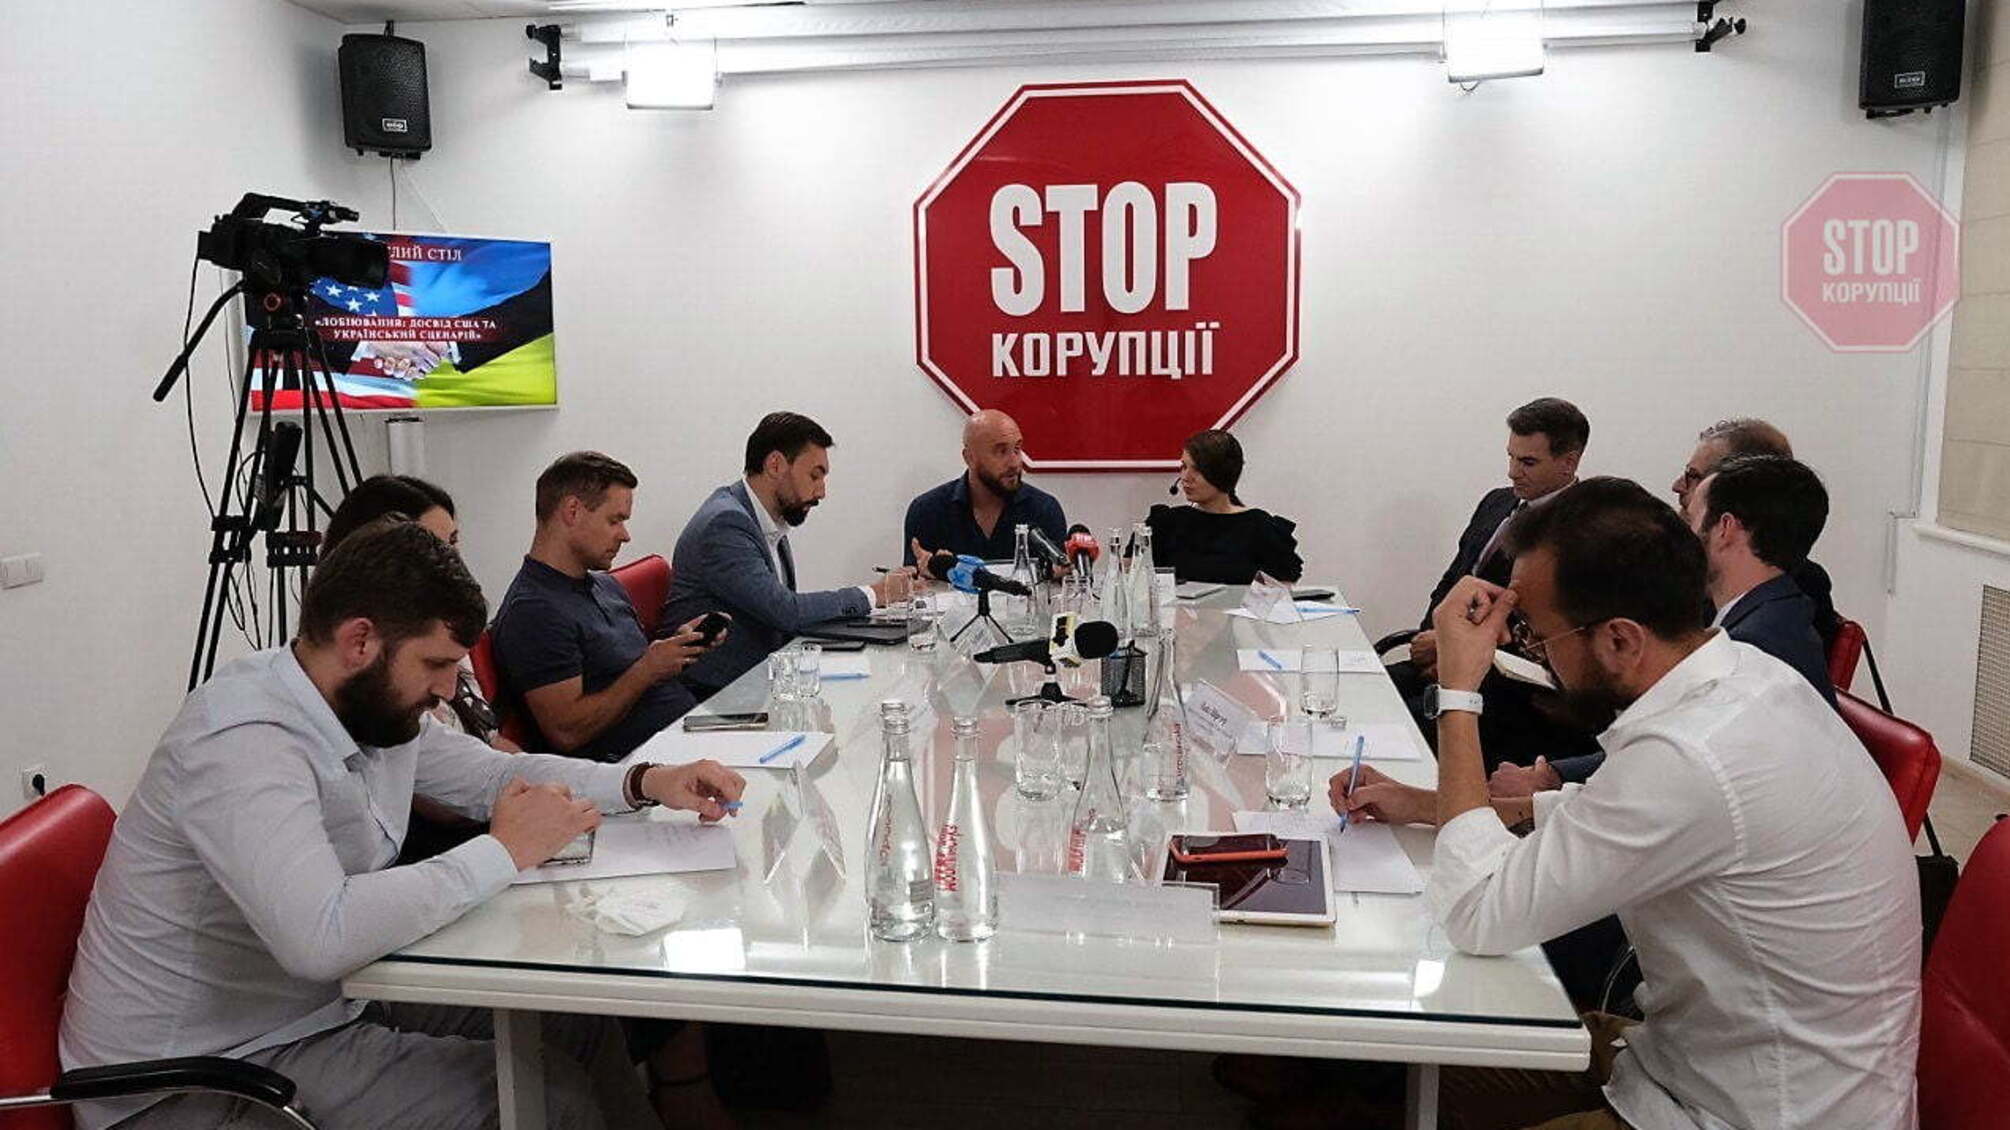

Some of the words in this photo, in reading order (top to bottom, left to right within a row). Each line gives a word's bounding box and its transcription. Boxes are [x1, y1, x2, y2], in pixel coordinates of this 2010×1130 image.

[387, 245, 422, 260] ЛИЙ
[427, 247, 463, 261] СТІЛ
[989, 181, 1217, 316] STOP
[454, 320, 479, 329] США
[483, 321, 496, 329] ТА
[333, 329, 417, 340] УКРАЇНСЬКИЙ
[992, 321, 1220, 380] КОРУПЦІЇ
